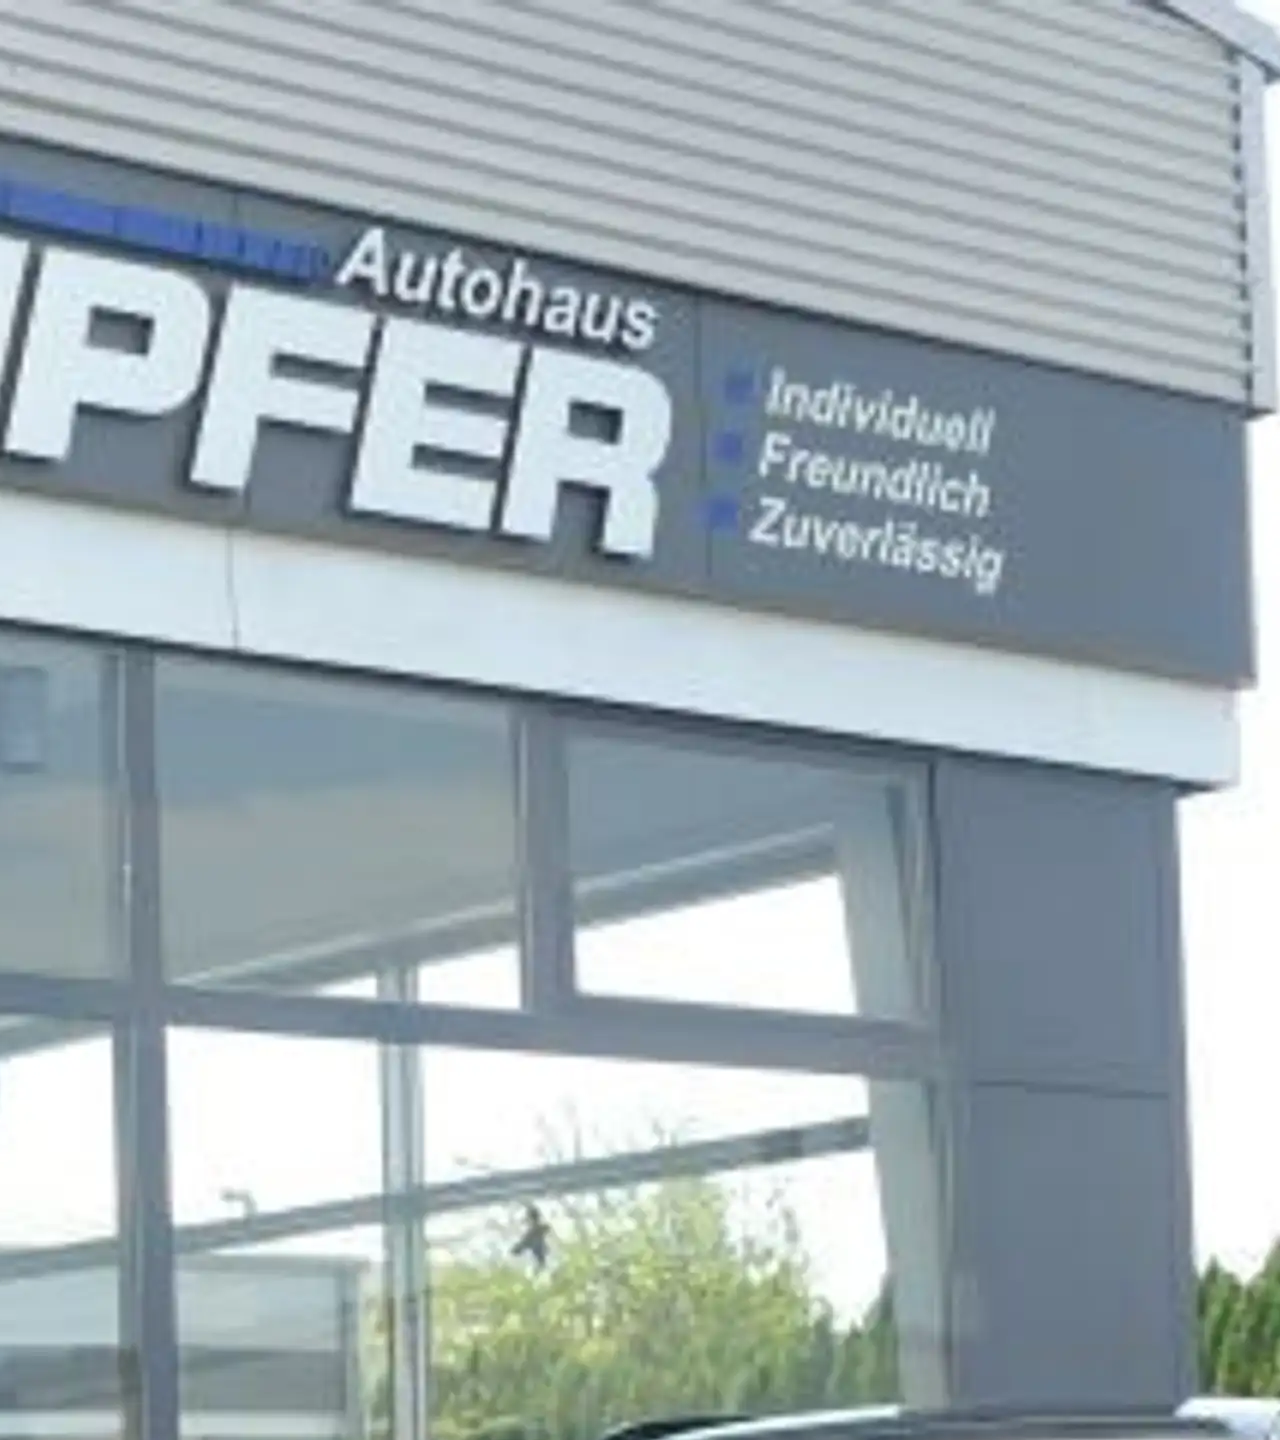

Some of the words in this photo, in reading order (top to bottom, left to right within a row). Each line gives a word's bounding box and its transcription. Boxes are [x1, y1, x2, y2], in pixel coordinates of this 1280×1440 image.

[333, 228, 660, 354] Autohaus
[764, 365, 997, 456] Individuell
[758, 430, 992, 519] Freundlich
[747, 496, 1005, 596] Zuverlässig
